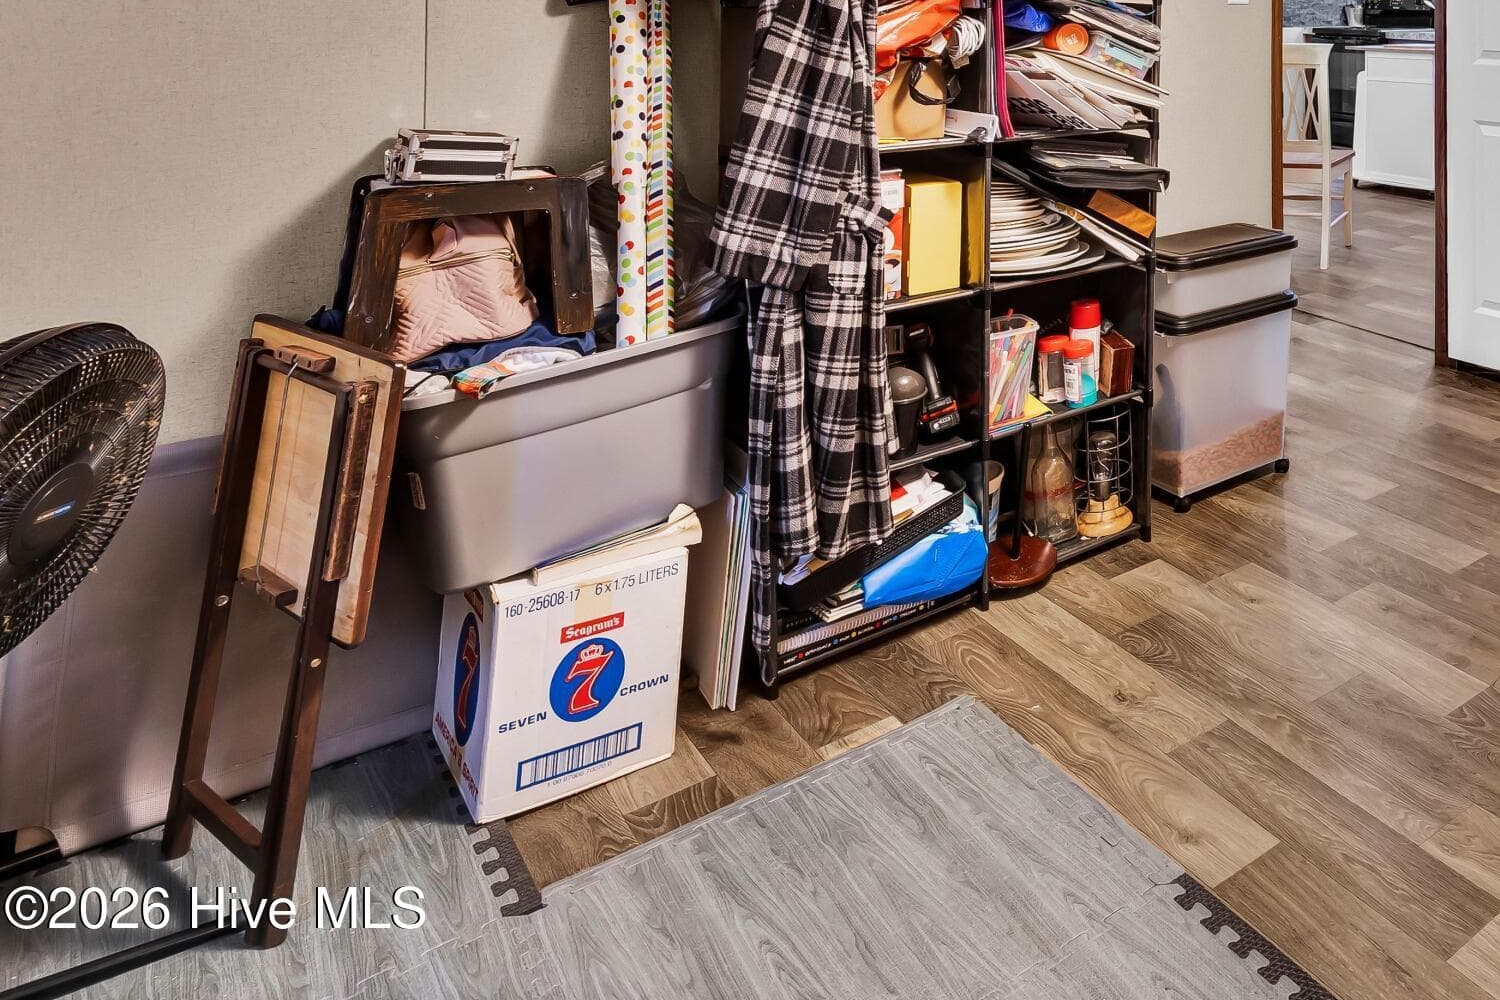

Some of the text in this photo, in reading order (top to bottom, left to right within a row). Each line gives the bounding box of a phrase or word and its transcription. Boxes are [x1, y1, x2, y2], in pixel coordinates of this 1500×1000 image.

[638, 563, 679, 585] LITERS
[565, 617, 620, 639] Seagram's
[565, 650, 614, 715] 7
[620, 674, 669, 697] CROWN
[498, 711, 548, 734] SEVEN
